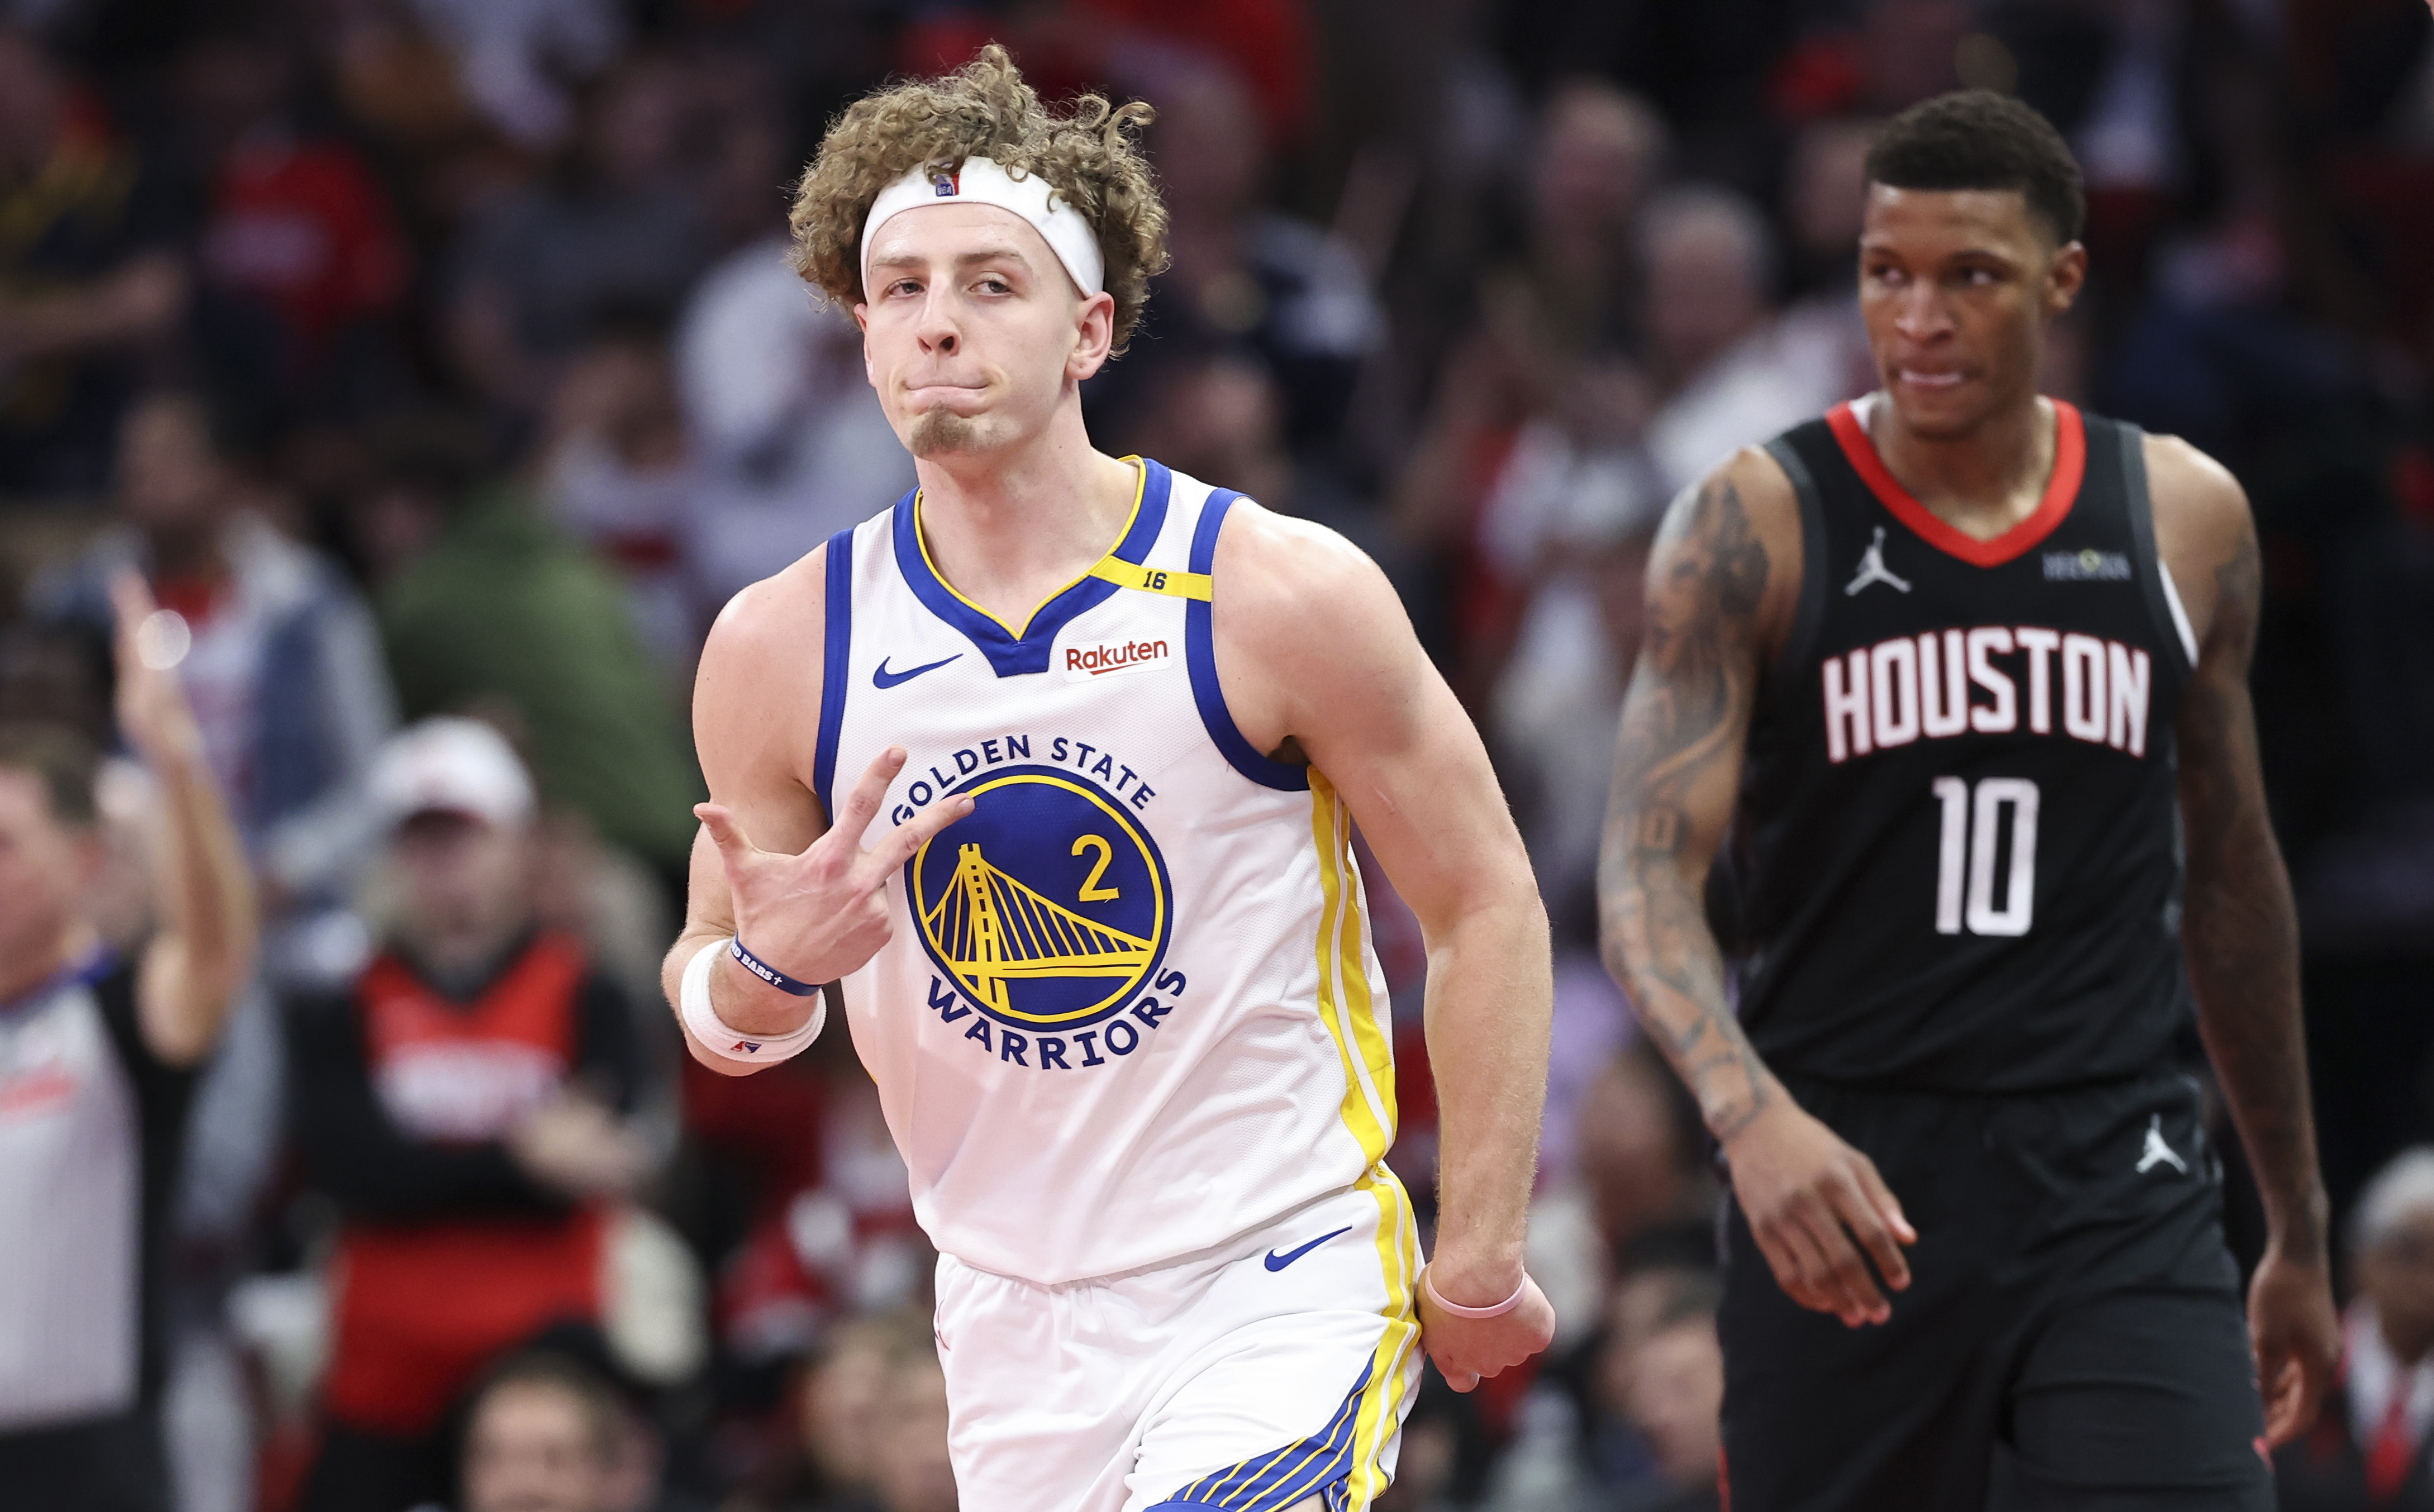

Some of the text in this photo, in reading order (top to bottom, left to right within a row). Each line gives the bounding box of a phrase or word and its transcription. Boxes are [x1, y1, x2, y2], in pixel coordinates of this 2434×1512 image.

[1143, 571, 1167, 590] 16
[1066, 640, 1168, 671] Rakuten
[1823, 626, 2150, 763] HOUSTON
[1051, 737, 1156, 810] STATE
[1071, 834, 1120, 903] 2
[1932, 776, 2040, 937] 10
[927, 967, 1187, 1070] WARRIORS
